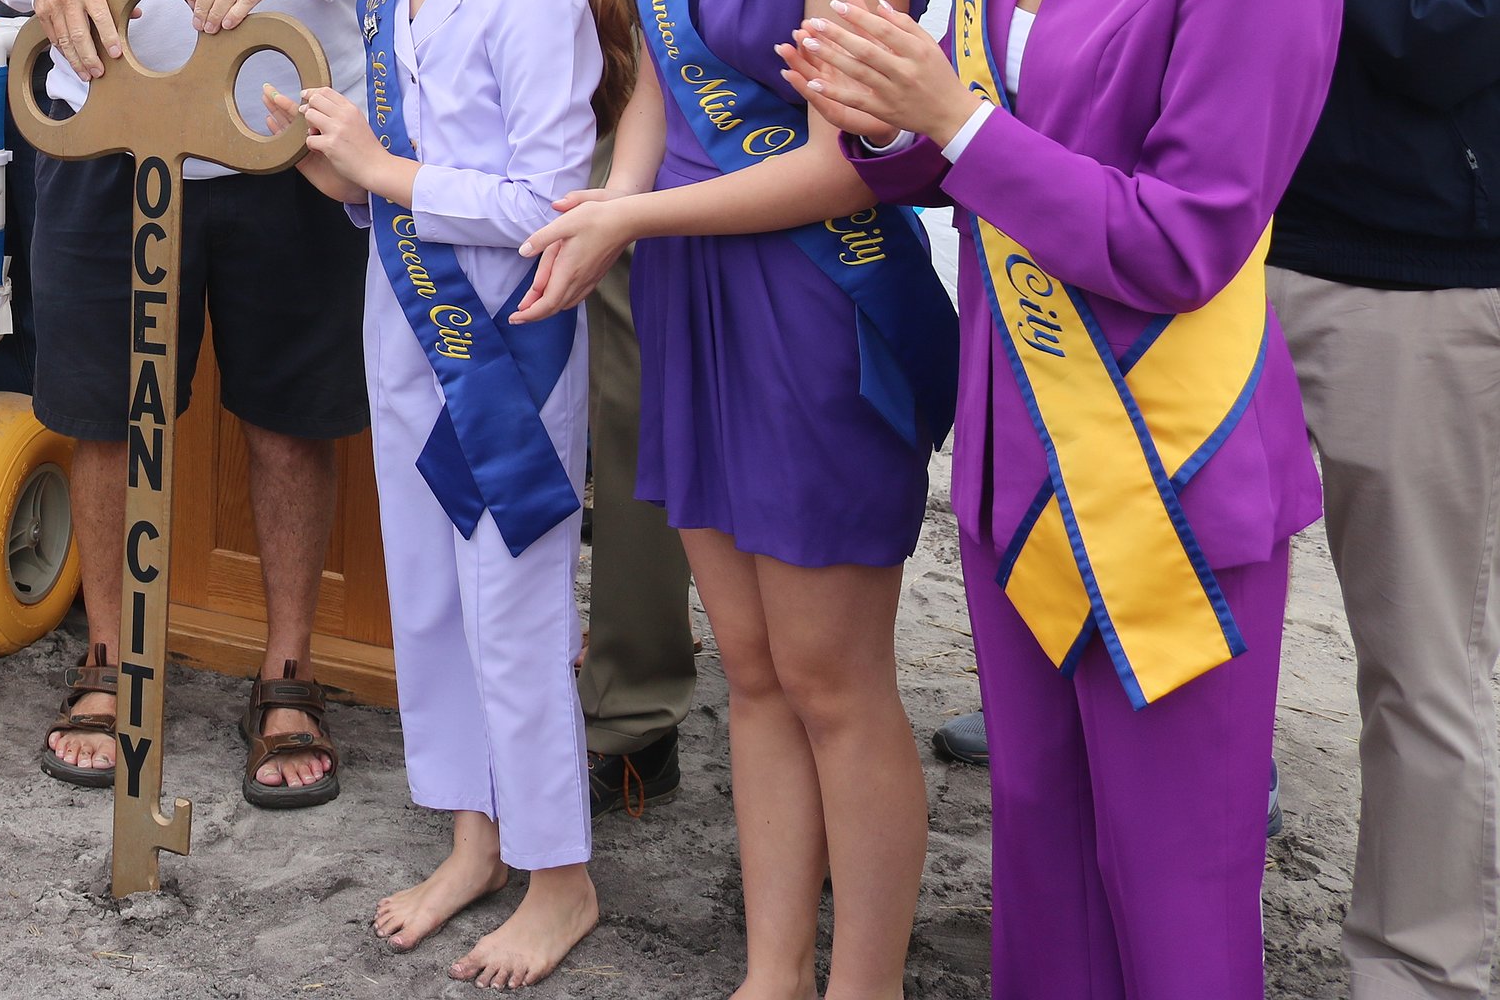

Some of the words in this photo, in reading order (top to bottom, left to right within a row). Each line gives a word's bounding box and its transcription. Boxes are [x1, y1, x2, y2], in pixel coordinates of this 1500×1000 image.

[371, 51, 393, 128] Little
[391, 214, 438, 300] Ocean
[429, 304, 473, 360] City
[680, 64, 745, 132] Miss
[127, 156, 172, 493] OCEAN
[1005, 253, 1066, 358] City
[117, 520, 161, 799] CITY
